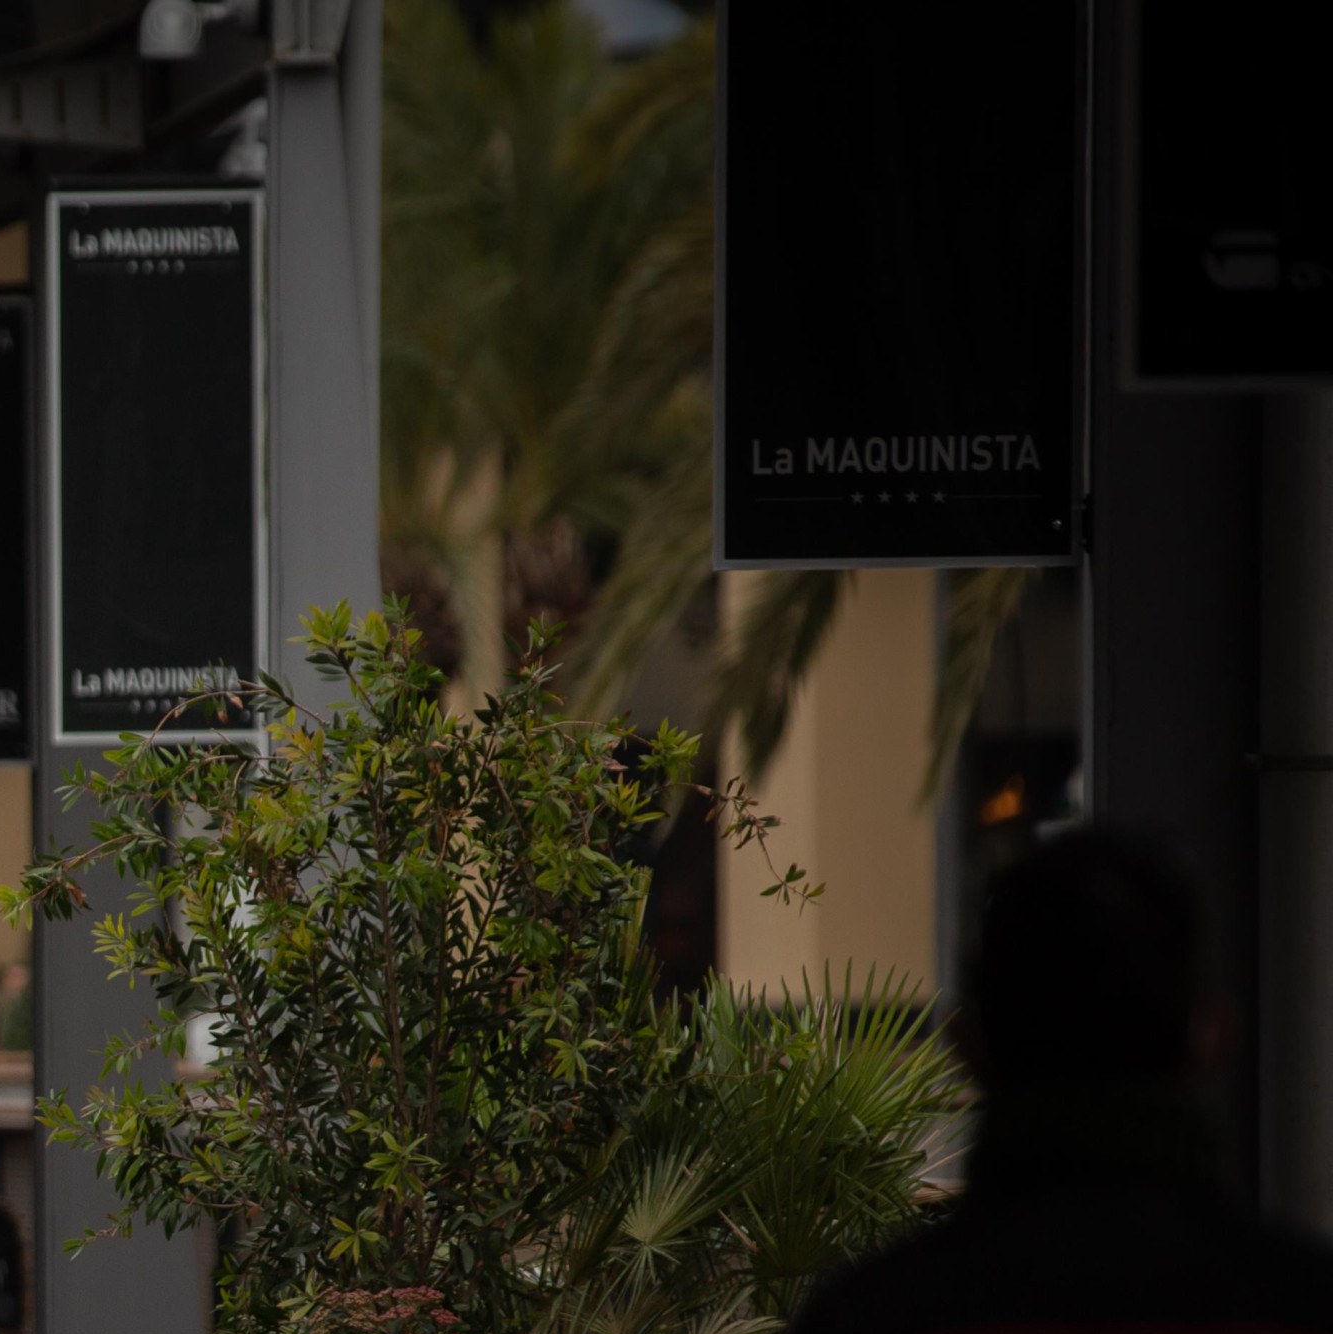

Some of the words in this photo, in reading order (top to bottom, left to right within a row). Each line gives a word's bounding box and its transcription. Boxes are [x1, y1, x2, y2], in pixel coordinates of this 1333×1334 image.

[67, 228, 99, 261] La
[101, 225, 240, 258] MAQUINISTA
[751, 438, 794, 476] La
[806, 433, 1042, 474] MAQUINISTA
[71, 668, 101, 698] La
